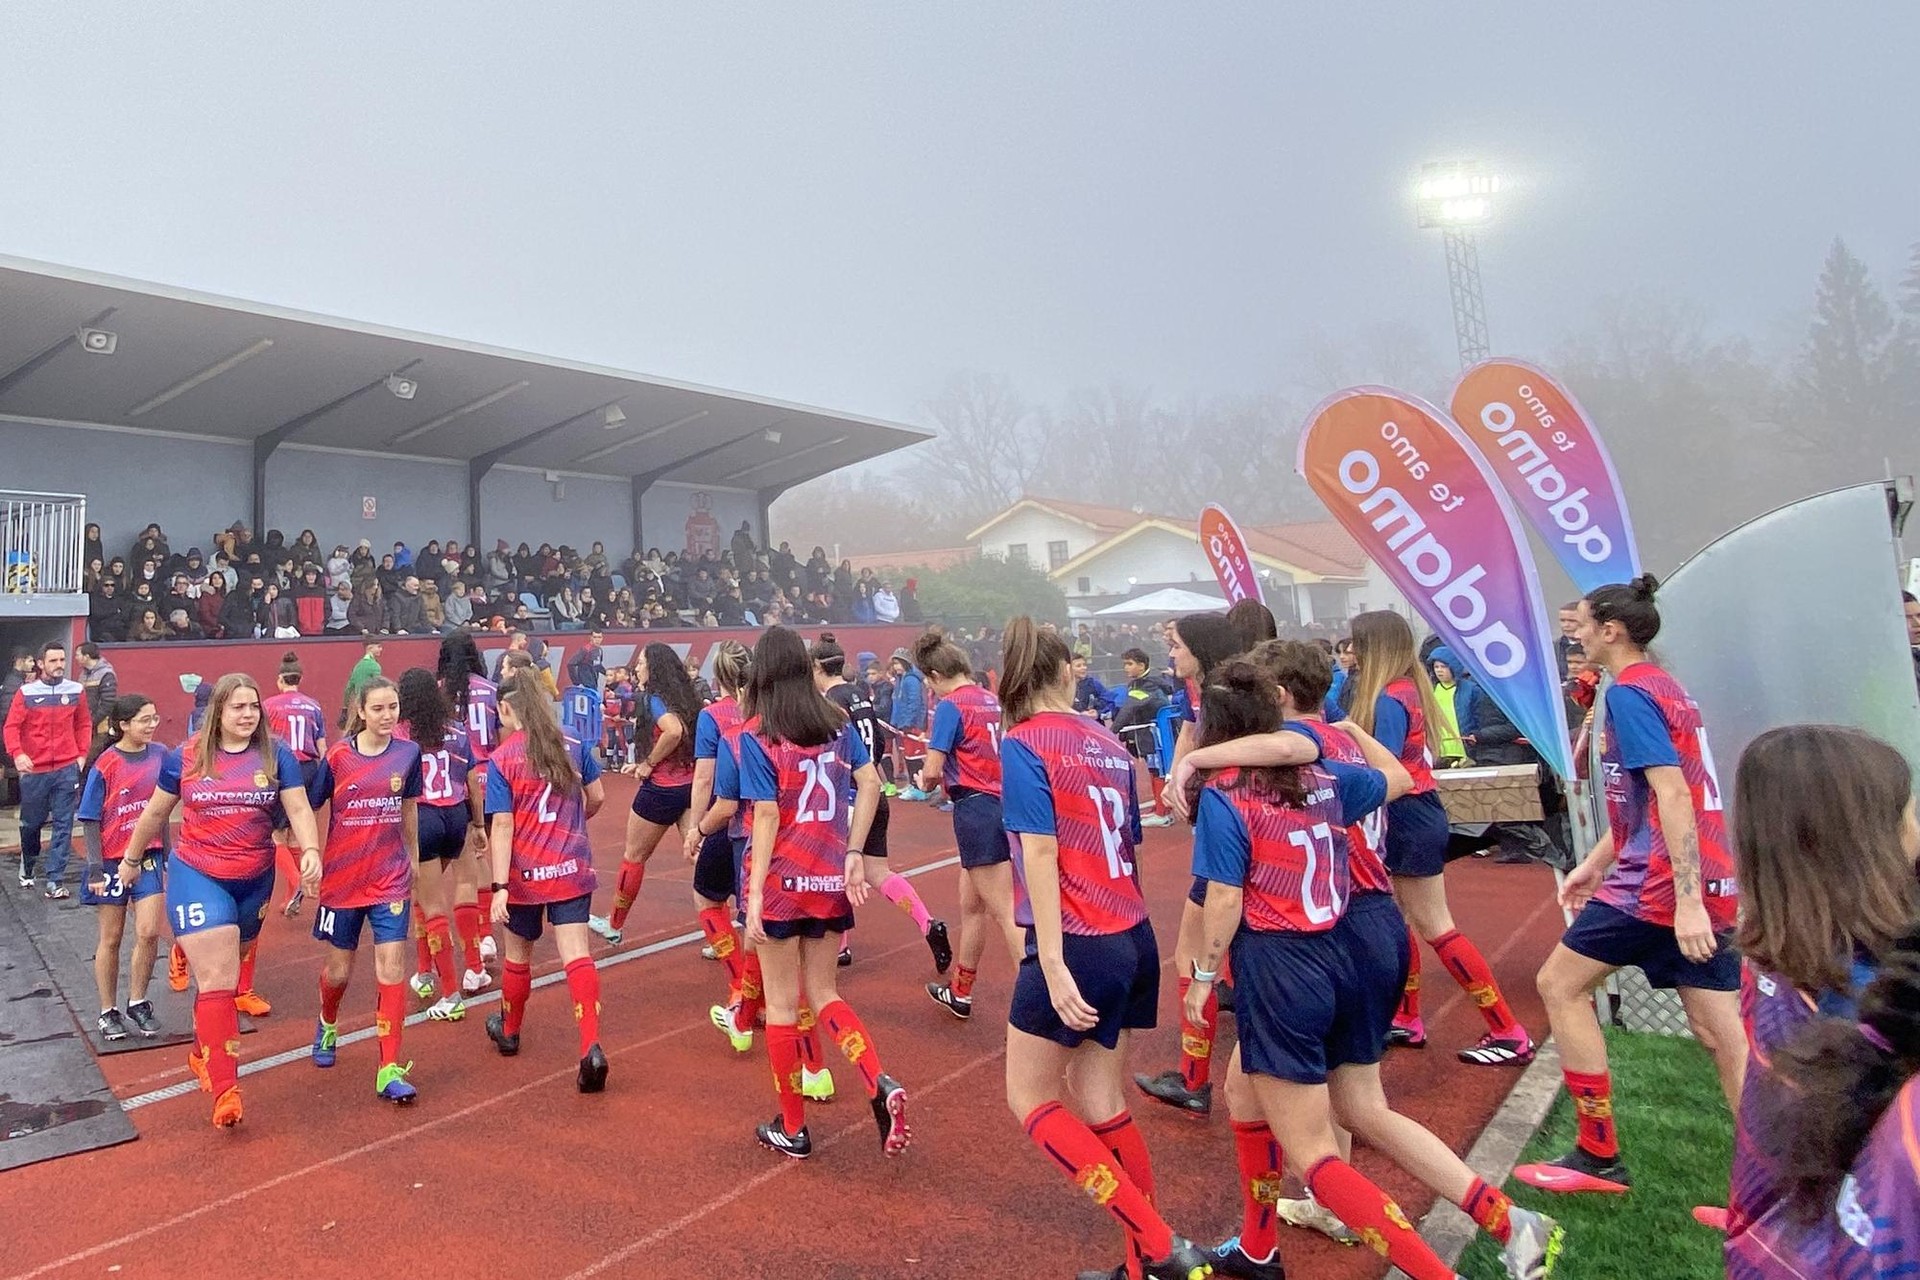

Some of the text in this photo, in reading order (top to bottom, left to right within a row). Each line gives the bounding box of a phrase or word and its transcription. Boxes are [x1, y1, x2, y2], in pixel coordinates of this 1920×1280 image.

[287, 715, 306, 751] 11
[421, 749, 453, 800] 23
[796, 751, 836, 823] 25
[175, 902, 206, 930] 15
[318, 906, 336, 936] 14
